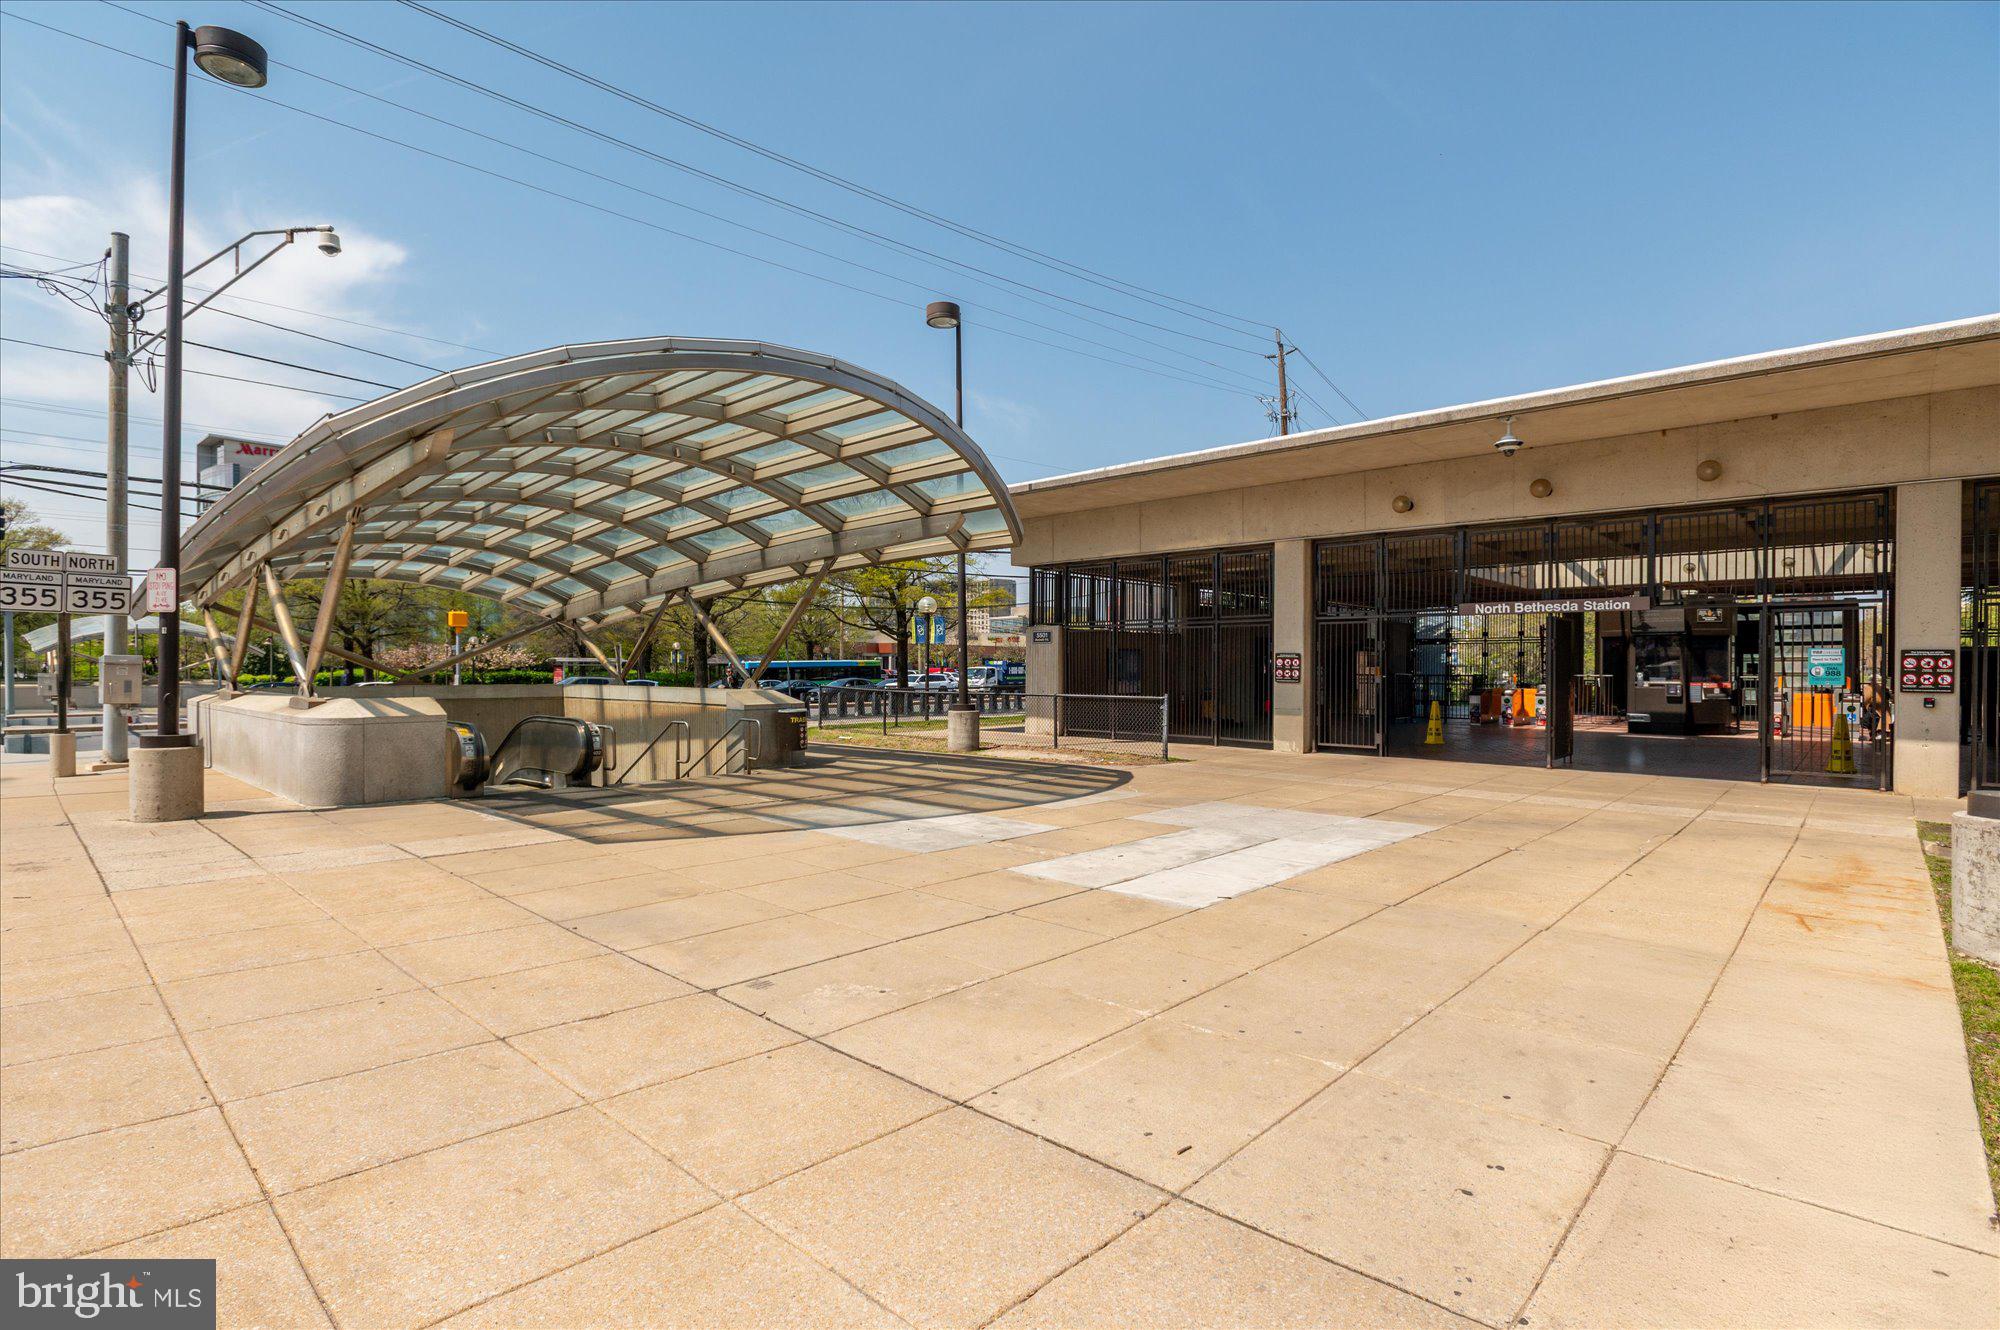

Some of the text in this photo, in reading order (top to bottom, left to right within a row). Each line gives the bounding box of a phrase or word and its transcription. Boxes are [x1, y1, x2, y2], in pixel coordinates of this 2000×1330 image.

[235, 443, 280, 457] Marr
[11, 552, 60, 567] SOUTH
[69, 557, 115, 571] NORTH
[3, 573, 54, 582] MARYLAND
[75, 577, 123, 586] MARYLAND
[155, 572, 167, 581] NO
[0, 587, 57, 607] 355
[72, 590, 126, 610] 355
[1475, 600, 1630, 614] North Bethesda Station
